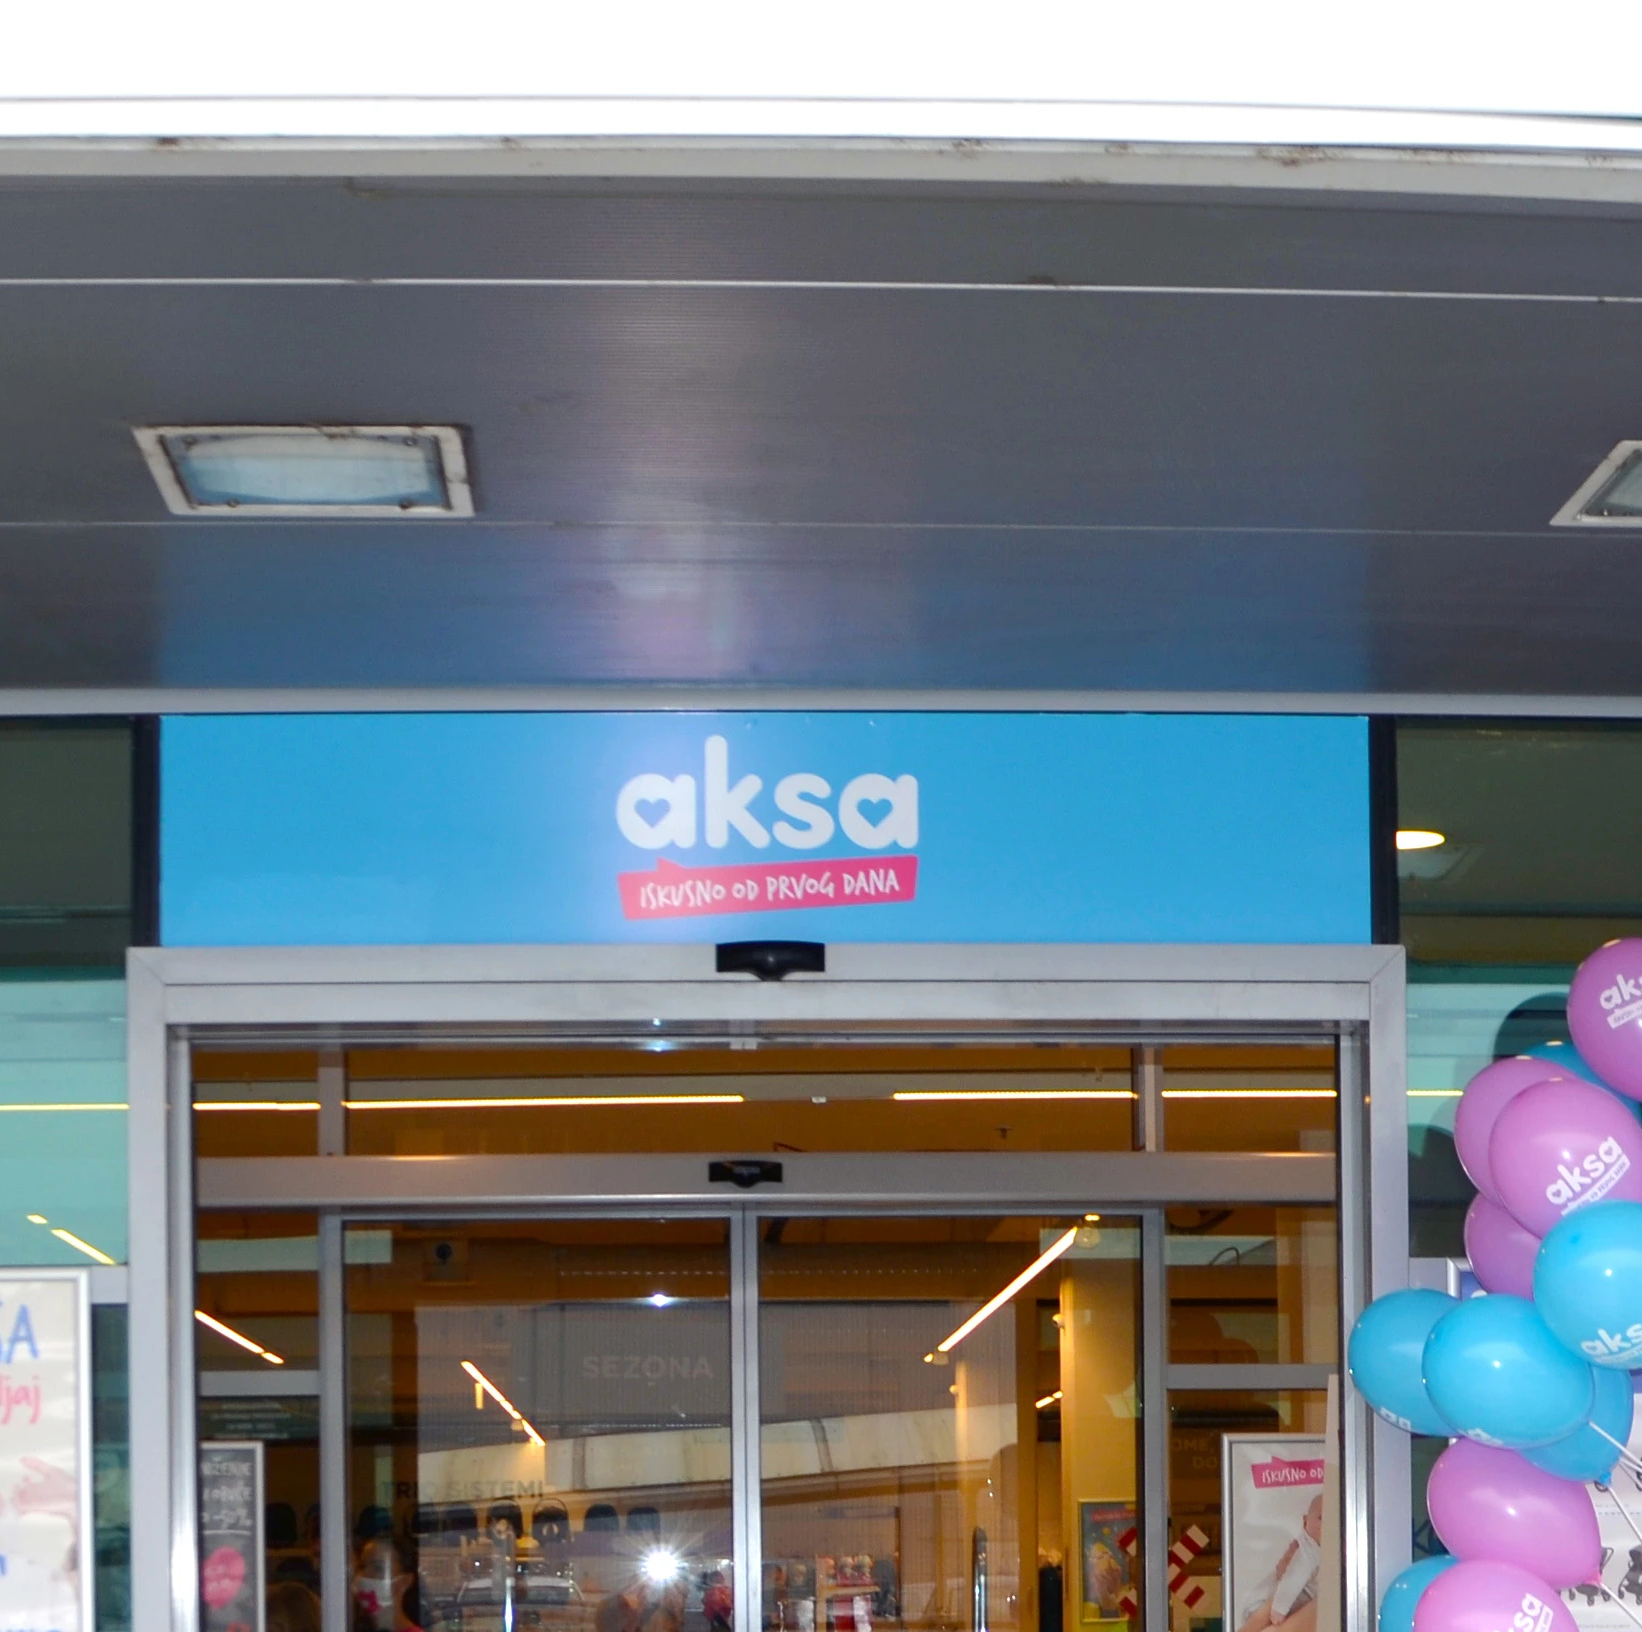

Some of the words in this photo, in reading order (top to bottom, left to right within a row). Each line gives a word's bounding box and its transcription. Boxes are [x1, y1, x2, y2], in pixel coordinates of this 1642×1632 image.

[616, 734, 919, 850] aksa
[640, 880, 726, 909] ISKUSNO
[731, 880, 759, 901] OD
[766, 872, 835, 901] PRVOG
[843, 868, 900, 895] DANA
[1546, 1136, 1622, 1205] aksa
[581, 1355, 714, 1380] SEZONA
[445, 1479, 545, 1499] SISTEMI
[1262, 1464, 1306, 1484] ISKUSNO
